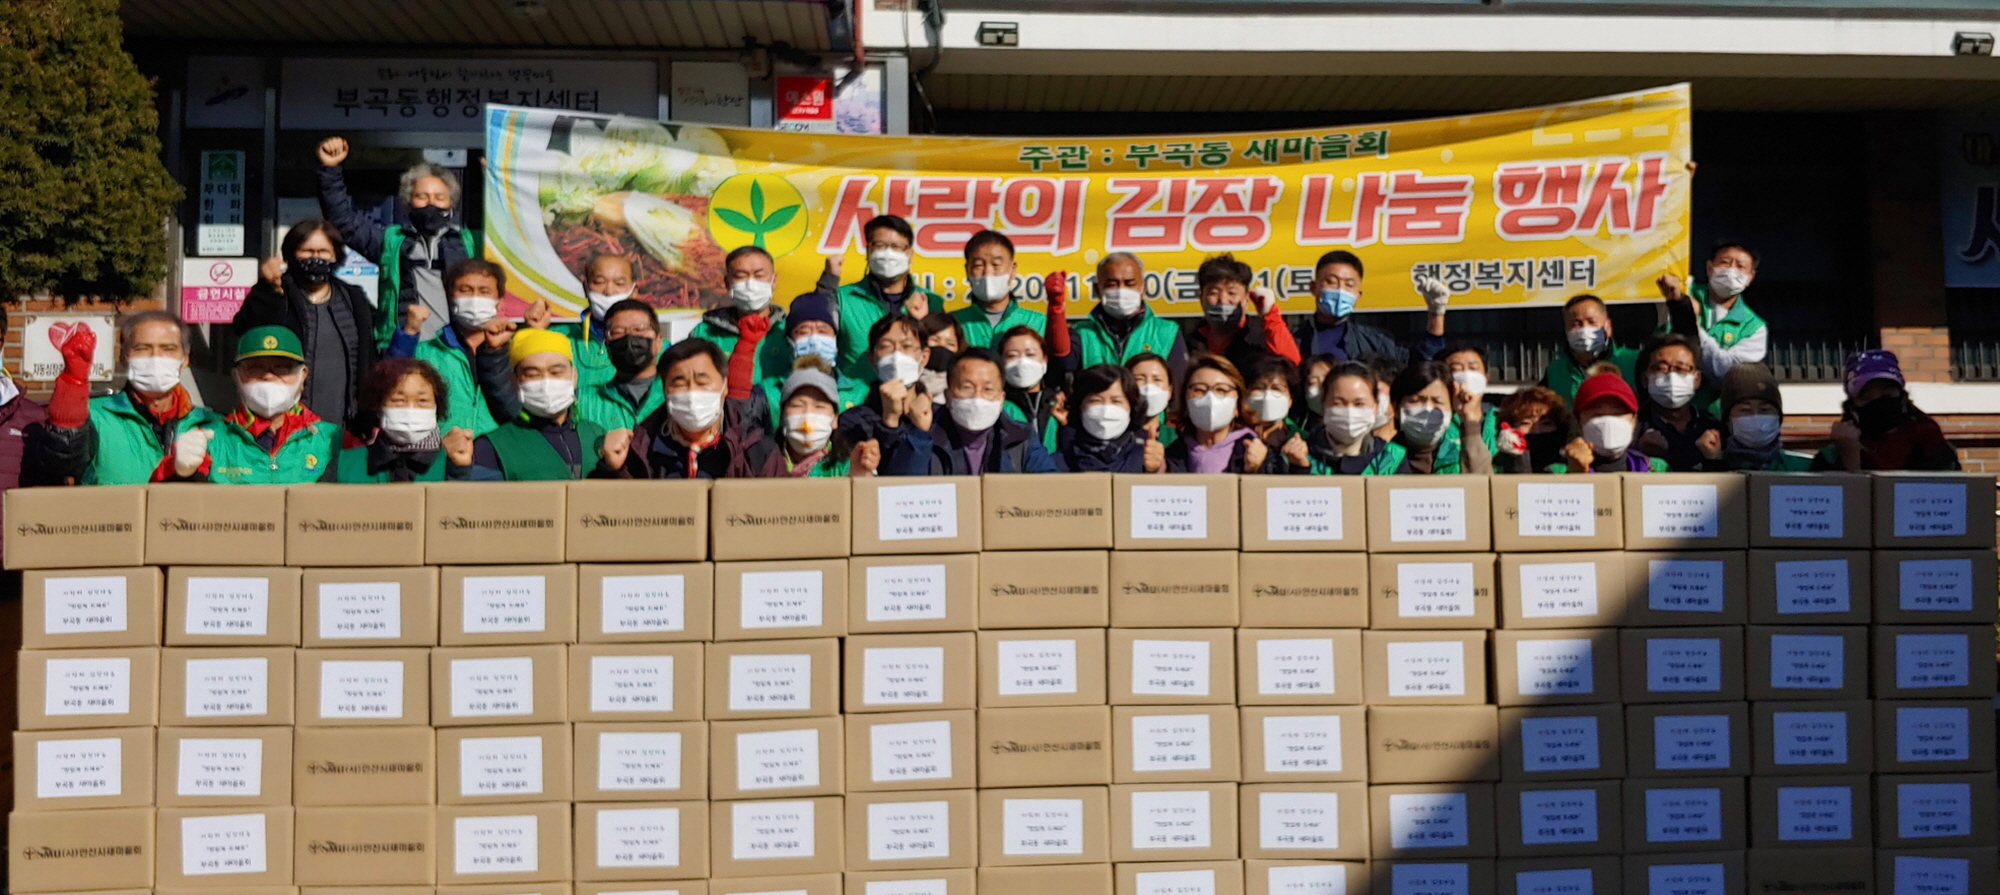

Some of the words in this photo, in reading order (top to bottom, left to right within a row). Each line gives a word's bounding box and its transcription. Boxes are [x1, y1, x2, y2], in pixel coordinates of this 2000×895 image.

[1018, 145, 1090, 170] 주관
[1125, 141, 1231, 168] 부곡동
[1243, 129, 1390, 163] 새마을회
[820, 176, 1086, 252] 사랑의
[1107, 176, 1279, 249] 김장
[1298, 171, 1472, 244] 나눔
[1497, 155, 1669, 238] 행사
